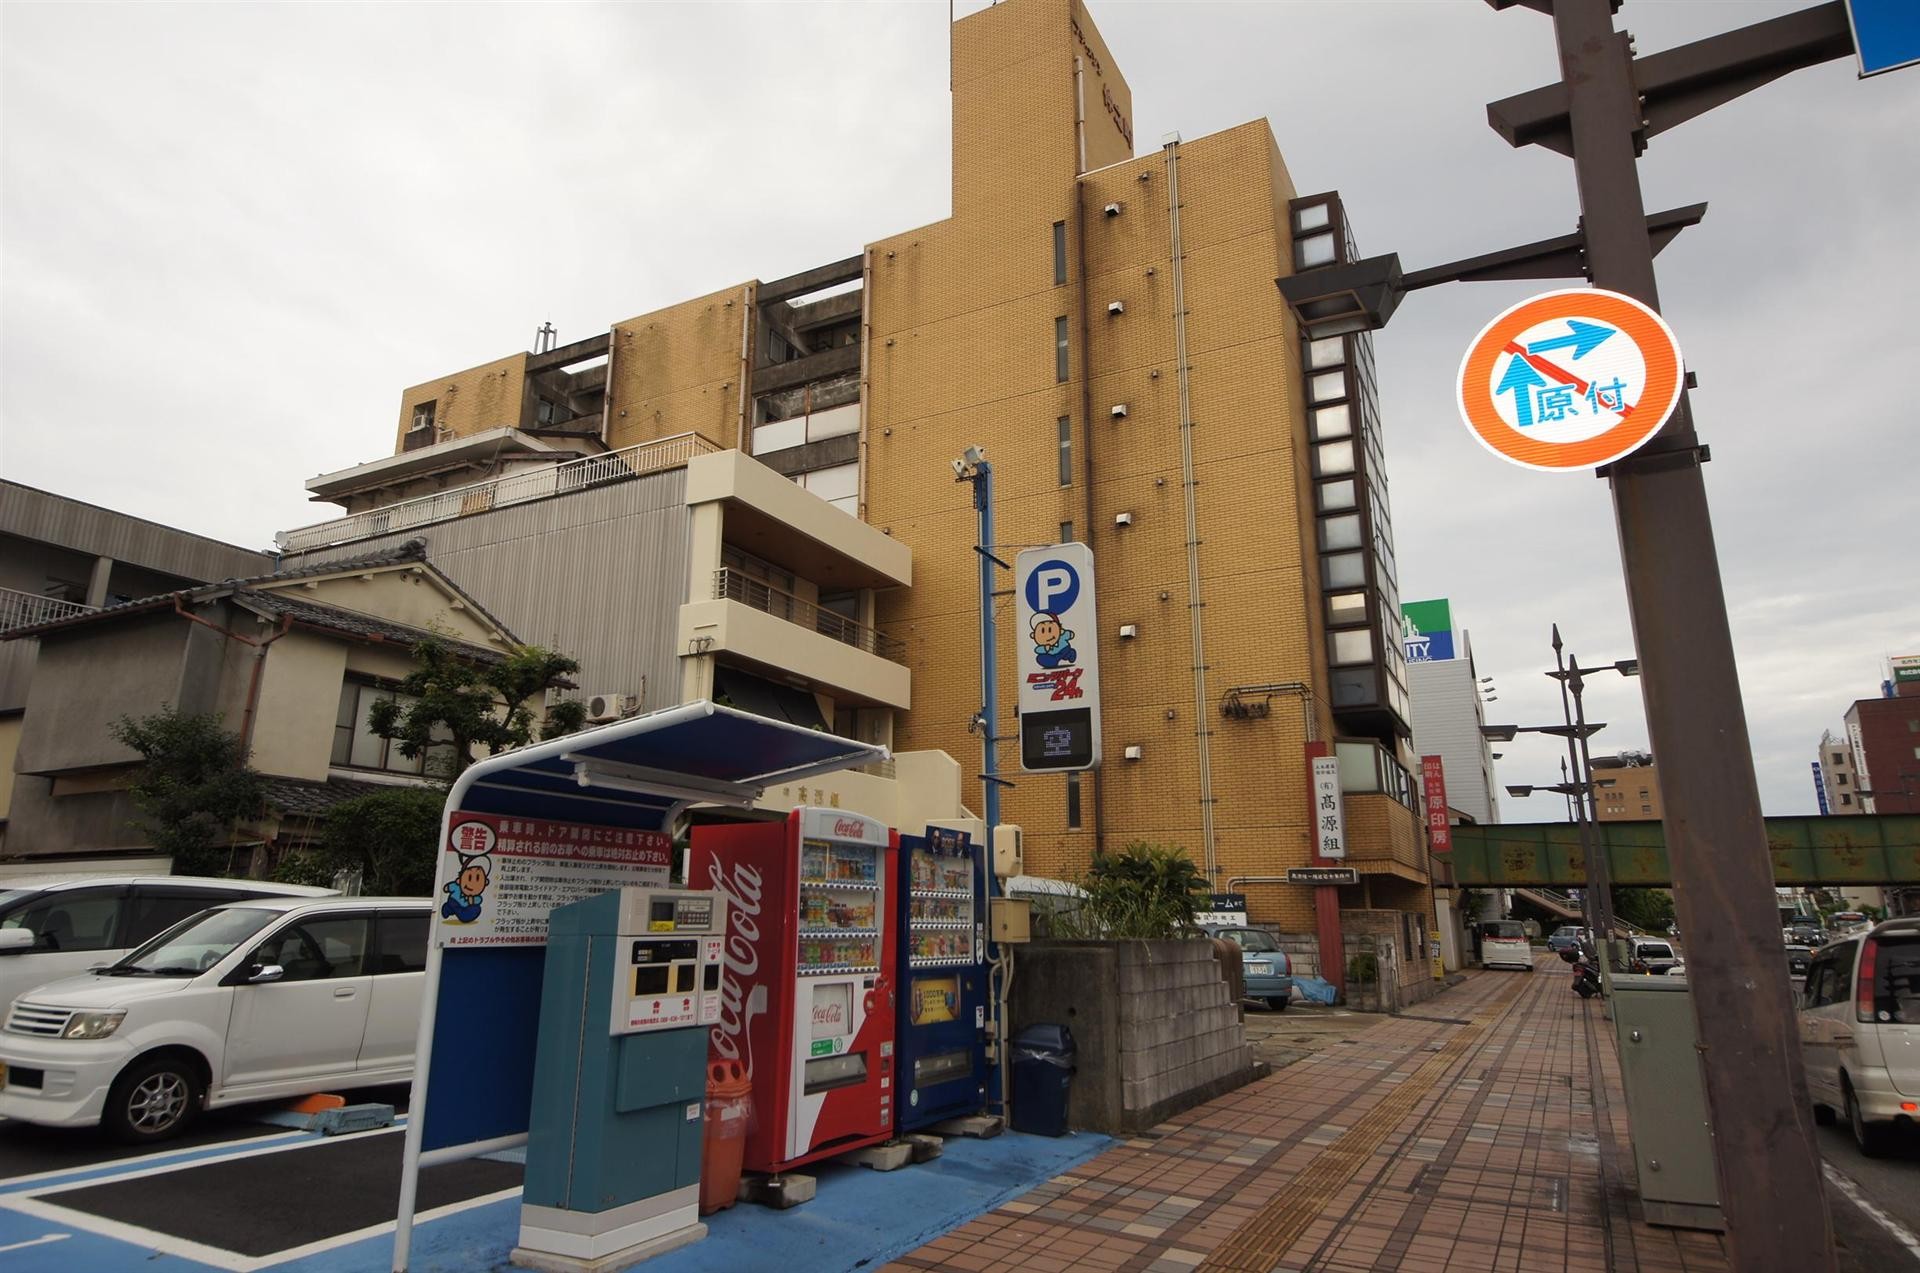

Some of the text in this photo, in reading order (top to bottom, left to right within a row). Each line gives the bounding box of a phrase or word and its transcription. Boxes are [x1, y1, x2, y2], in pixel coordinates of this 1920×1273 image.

[1536, 376, 1627, 423] 原付
[1038, 568, 1071, 610] P
[460, 826, 487, 850] 警告
[834, 817, 864, 839] Coca-Cola
